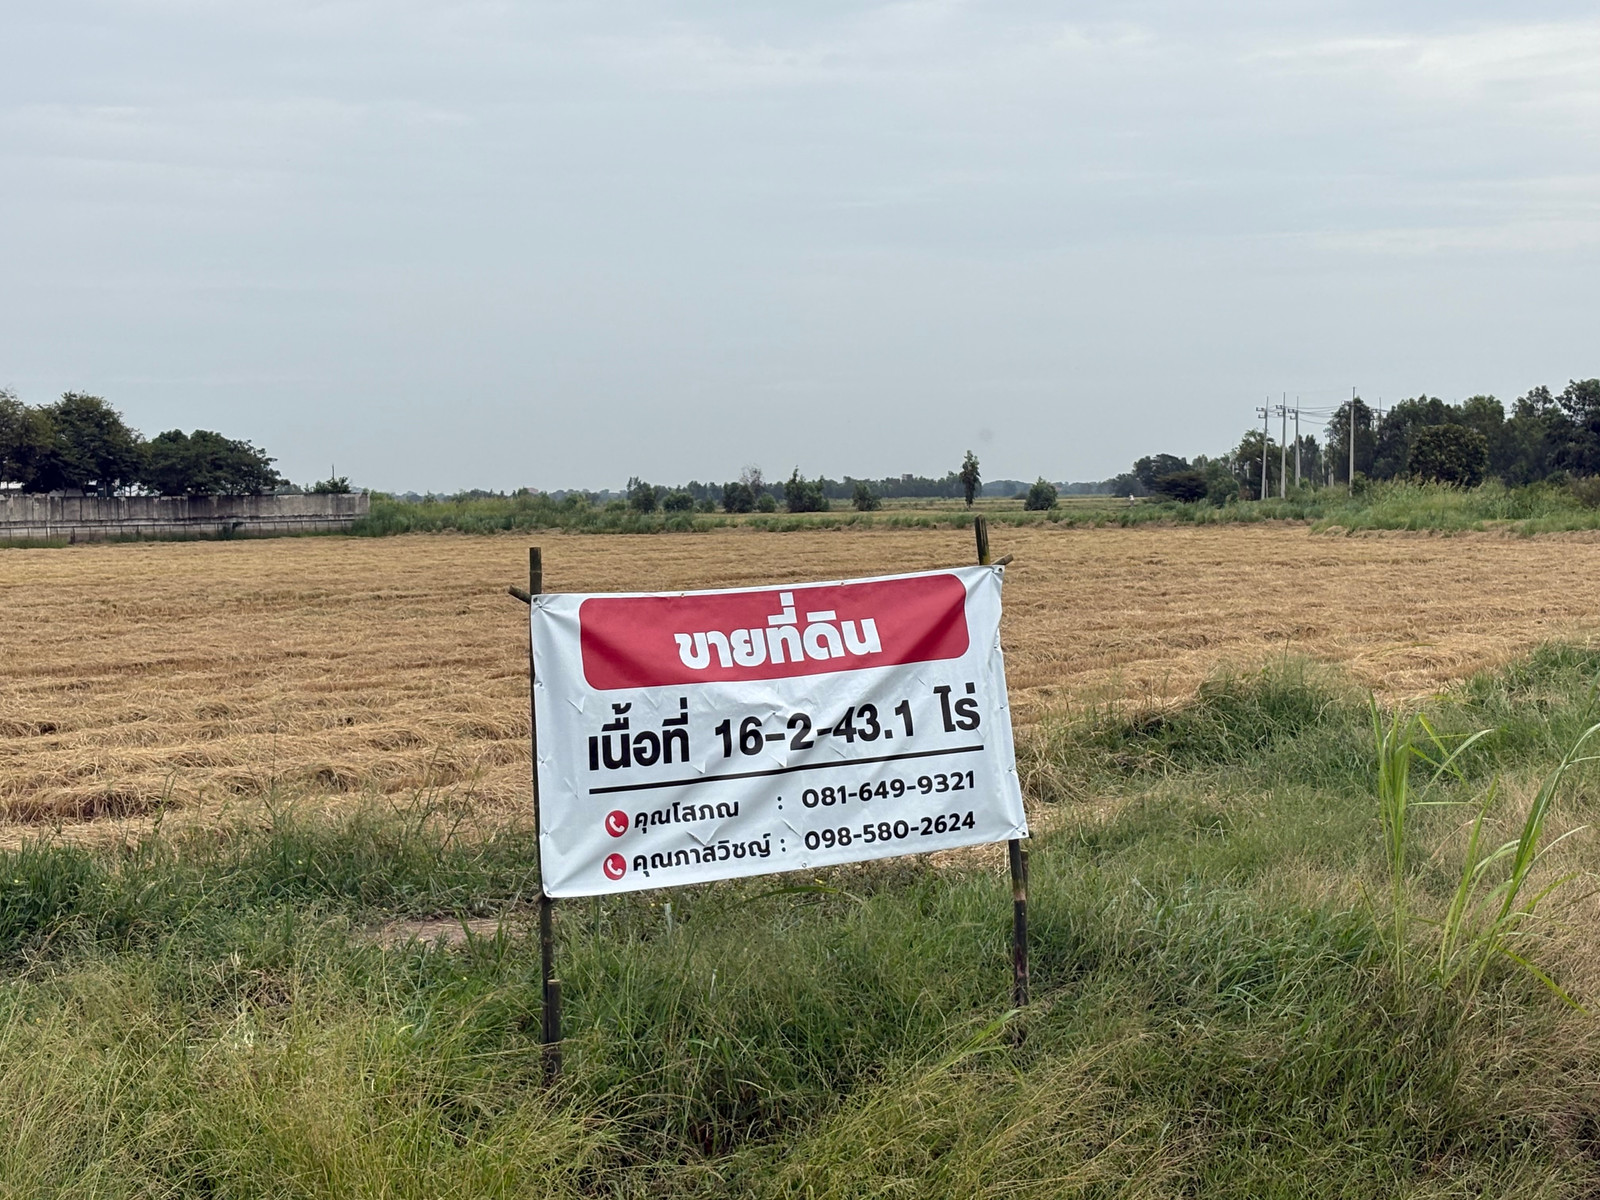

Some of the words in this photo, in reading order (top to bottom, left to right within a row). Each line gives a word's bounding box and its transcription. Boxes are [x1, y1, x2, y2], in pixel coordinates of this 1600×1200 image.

[673, 591, 882, 670] ขายที่ดิน
[588, 696, 690, 771] เนื้อที่
[714, 699, 915, 758] 16-2-43.1
[933, 681, 981, 733] ไร่
[634, 801, 739, 834] คุณโสภณ
[801, 770, 975, 809] 081-649-9321
[633, 833, 772, 877] คุณภาสวิชญ์
[804, 811, 976, 851] 098-580-2624
